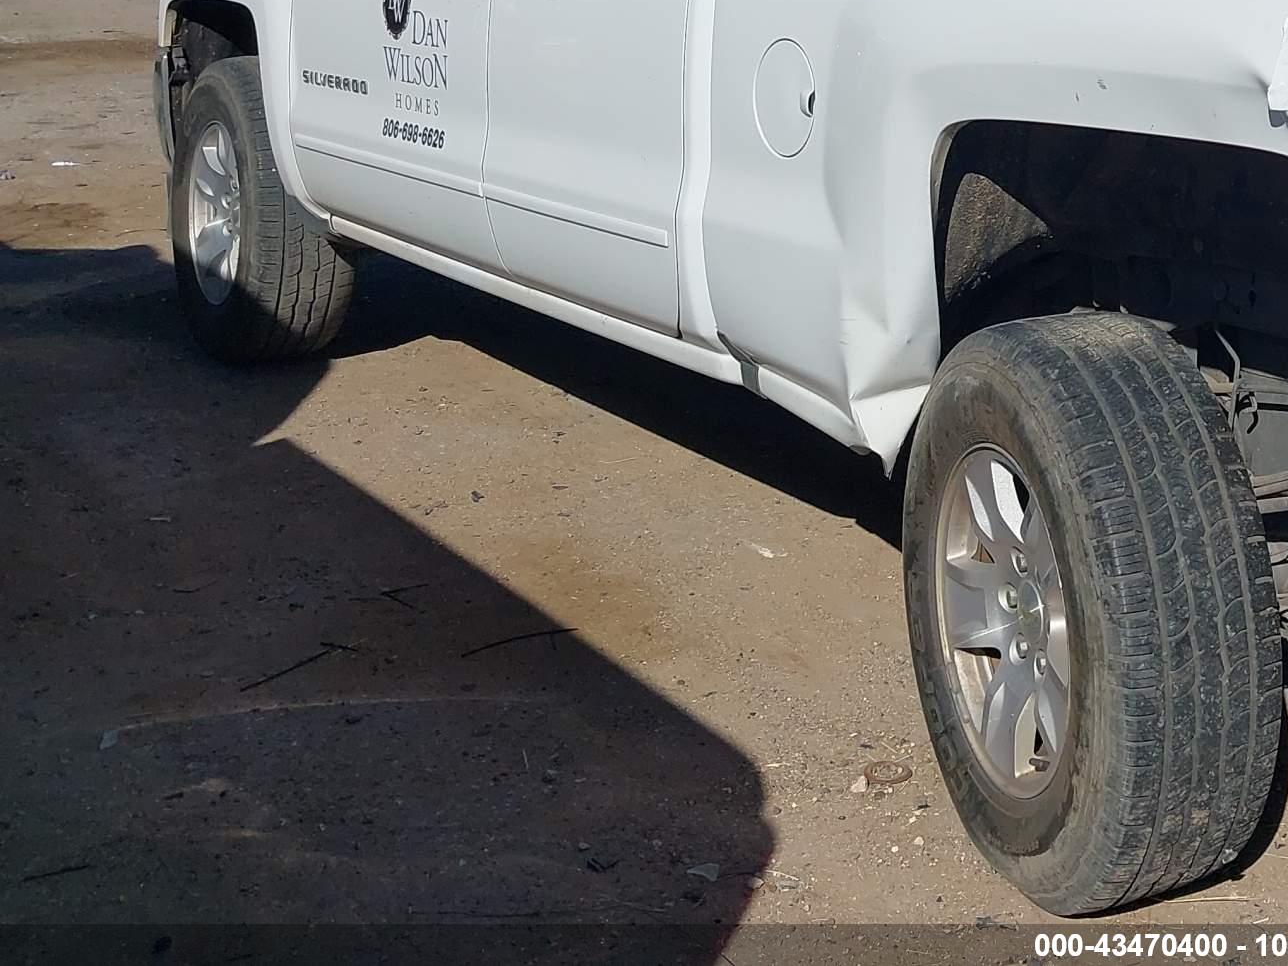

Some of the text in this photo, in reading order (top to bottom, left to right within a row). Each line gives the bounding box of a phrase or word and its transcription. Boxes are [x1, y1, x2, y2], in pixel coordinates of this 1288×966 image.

[302, 69, 368, 95] SILVERADO
[395, 92, 439, 116] HOMES
[383, 117, 446, 149] 806-698-6626
